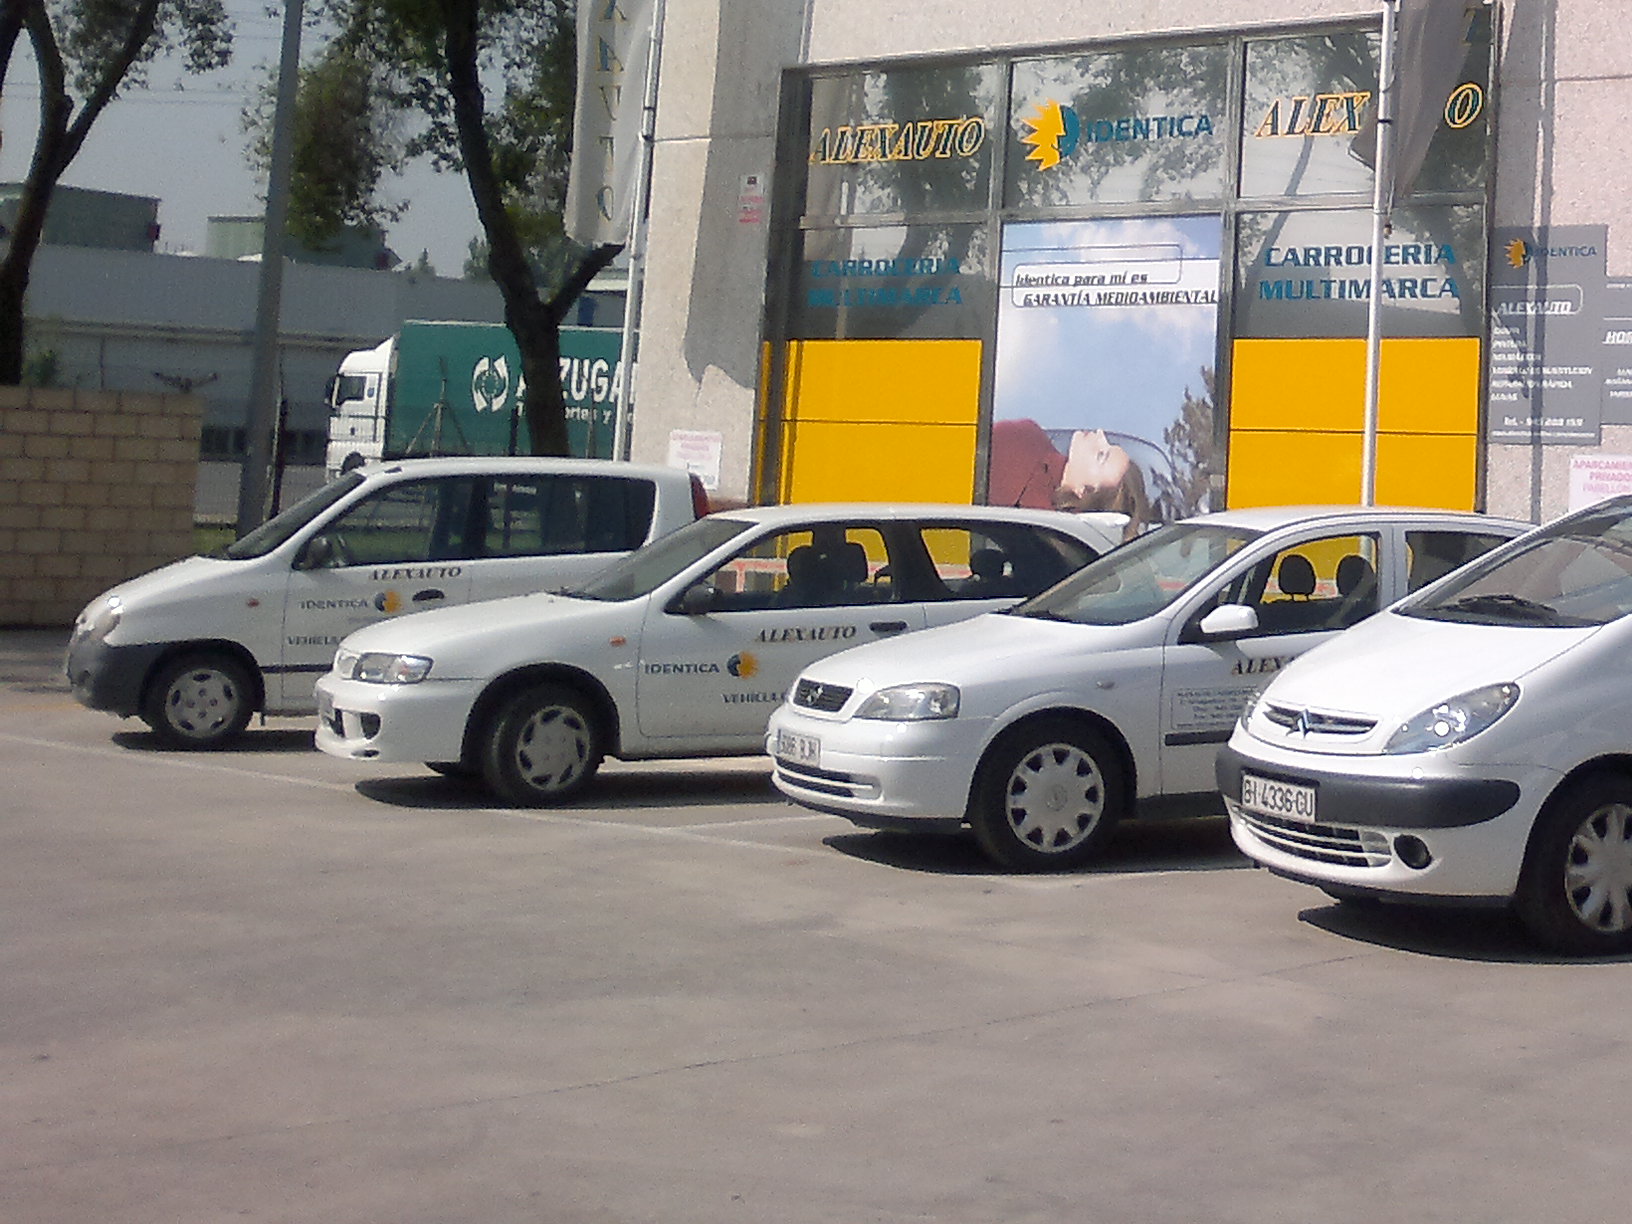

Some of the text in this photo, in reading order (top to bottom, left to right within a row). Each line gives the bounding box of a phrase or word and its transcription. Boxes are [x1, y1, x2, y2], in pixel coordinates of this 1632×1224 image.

[1088, 114, 1215, 143] IDENTICA
[808, 117, 986, 164] ALEXAUTO
[1015, 273, 1069, 287] Identica
[1073, 275, 1106, 287] para
[1131, 274, 1148, 284] es
[1096, 289, 1218, 305] MEDIOAMBIENTAL
[1500, 301, 1572, 315] ALEXAUTO
[371, 566, 462, 581] ALEXAUTO
[300, 599, 368, 610] IDENTICA
[758, 625, 856, 643] ALEXAUTO
[645, 663, 720, 674] IDENTICA
[1232, 655, 1296, 675] ALEX
